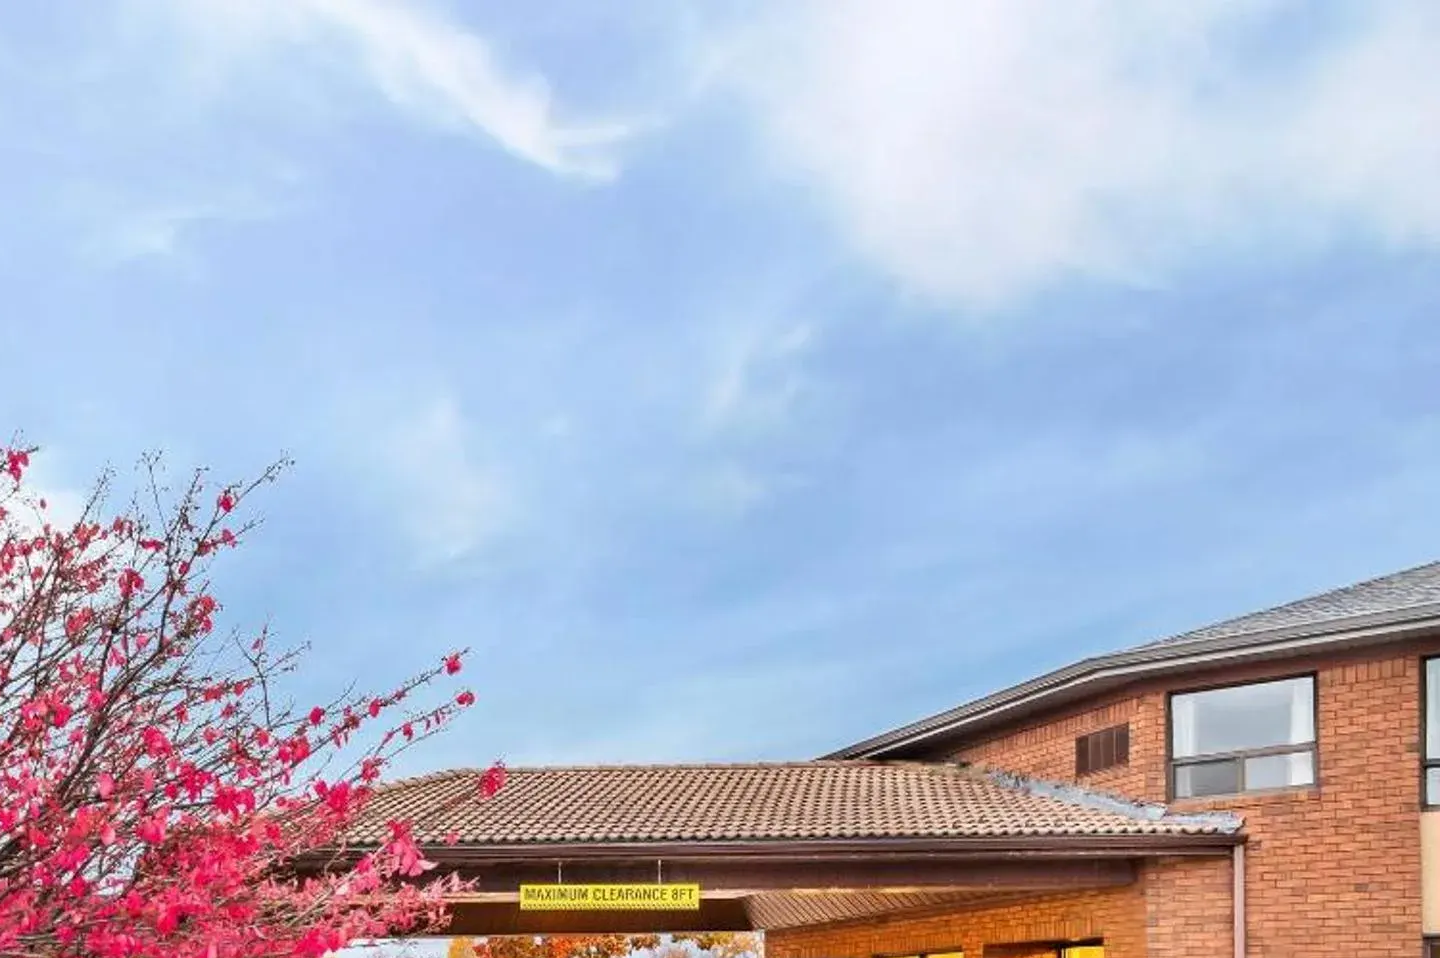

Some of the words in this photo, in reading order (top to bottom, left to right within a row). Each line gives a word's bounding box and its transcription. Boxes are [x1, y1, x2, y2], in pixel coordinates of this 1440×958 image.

[523, 887, 589, 901] MAXIMUM
[592, 887, 667, 901] CLEARANCE
[671, 887, 695, 901] 8FT
